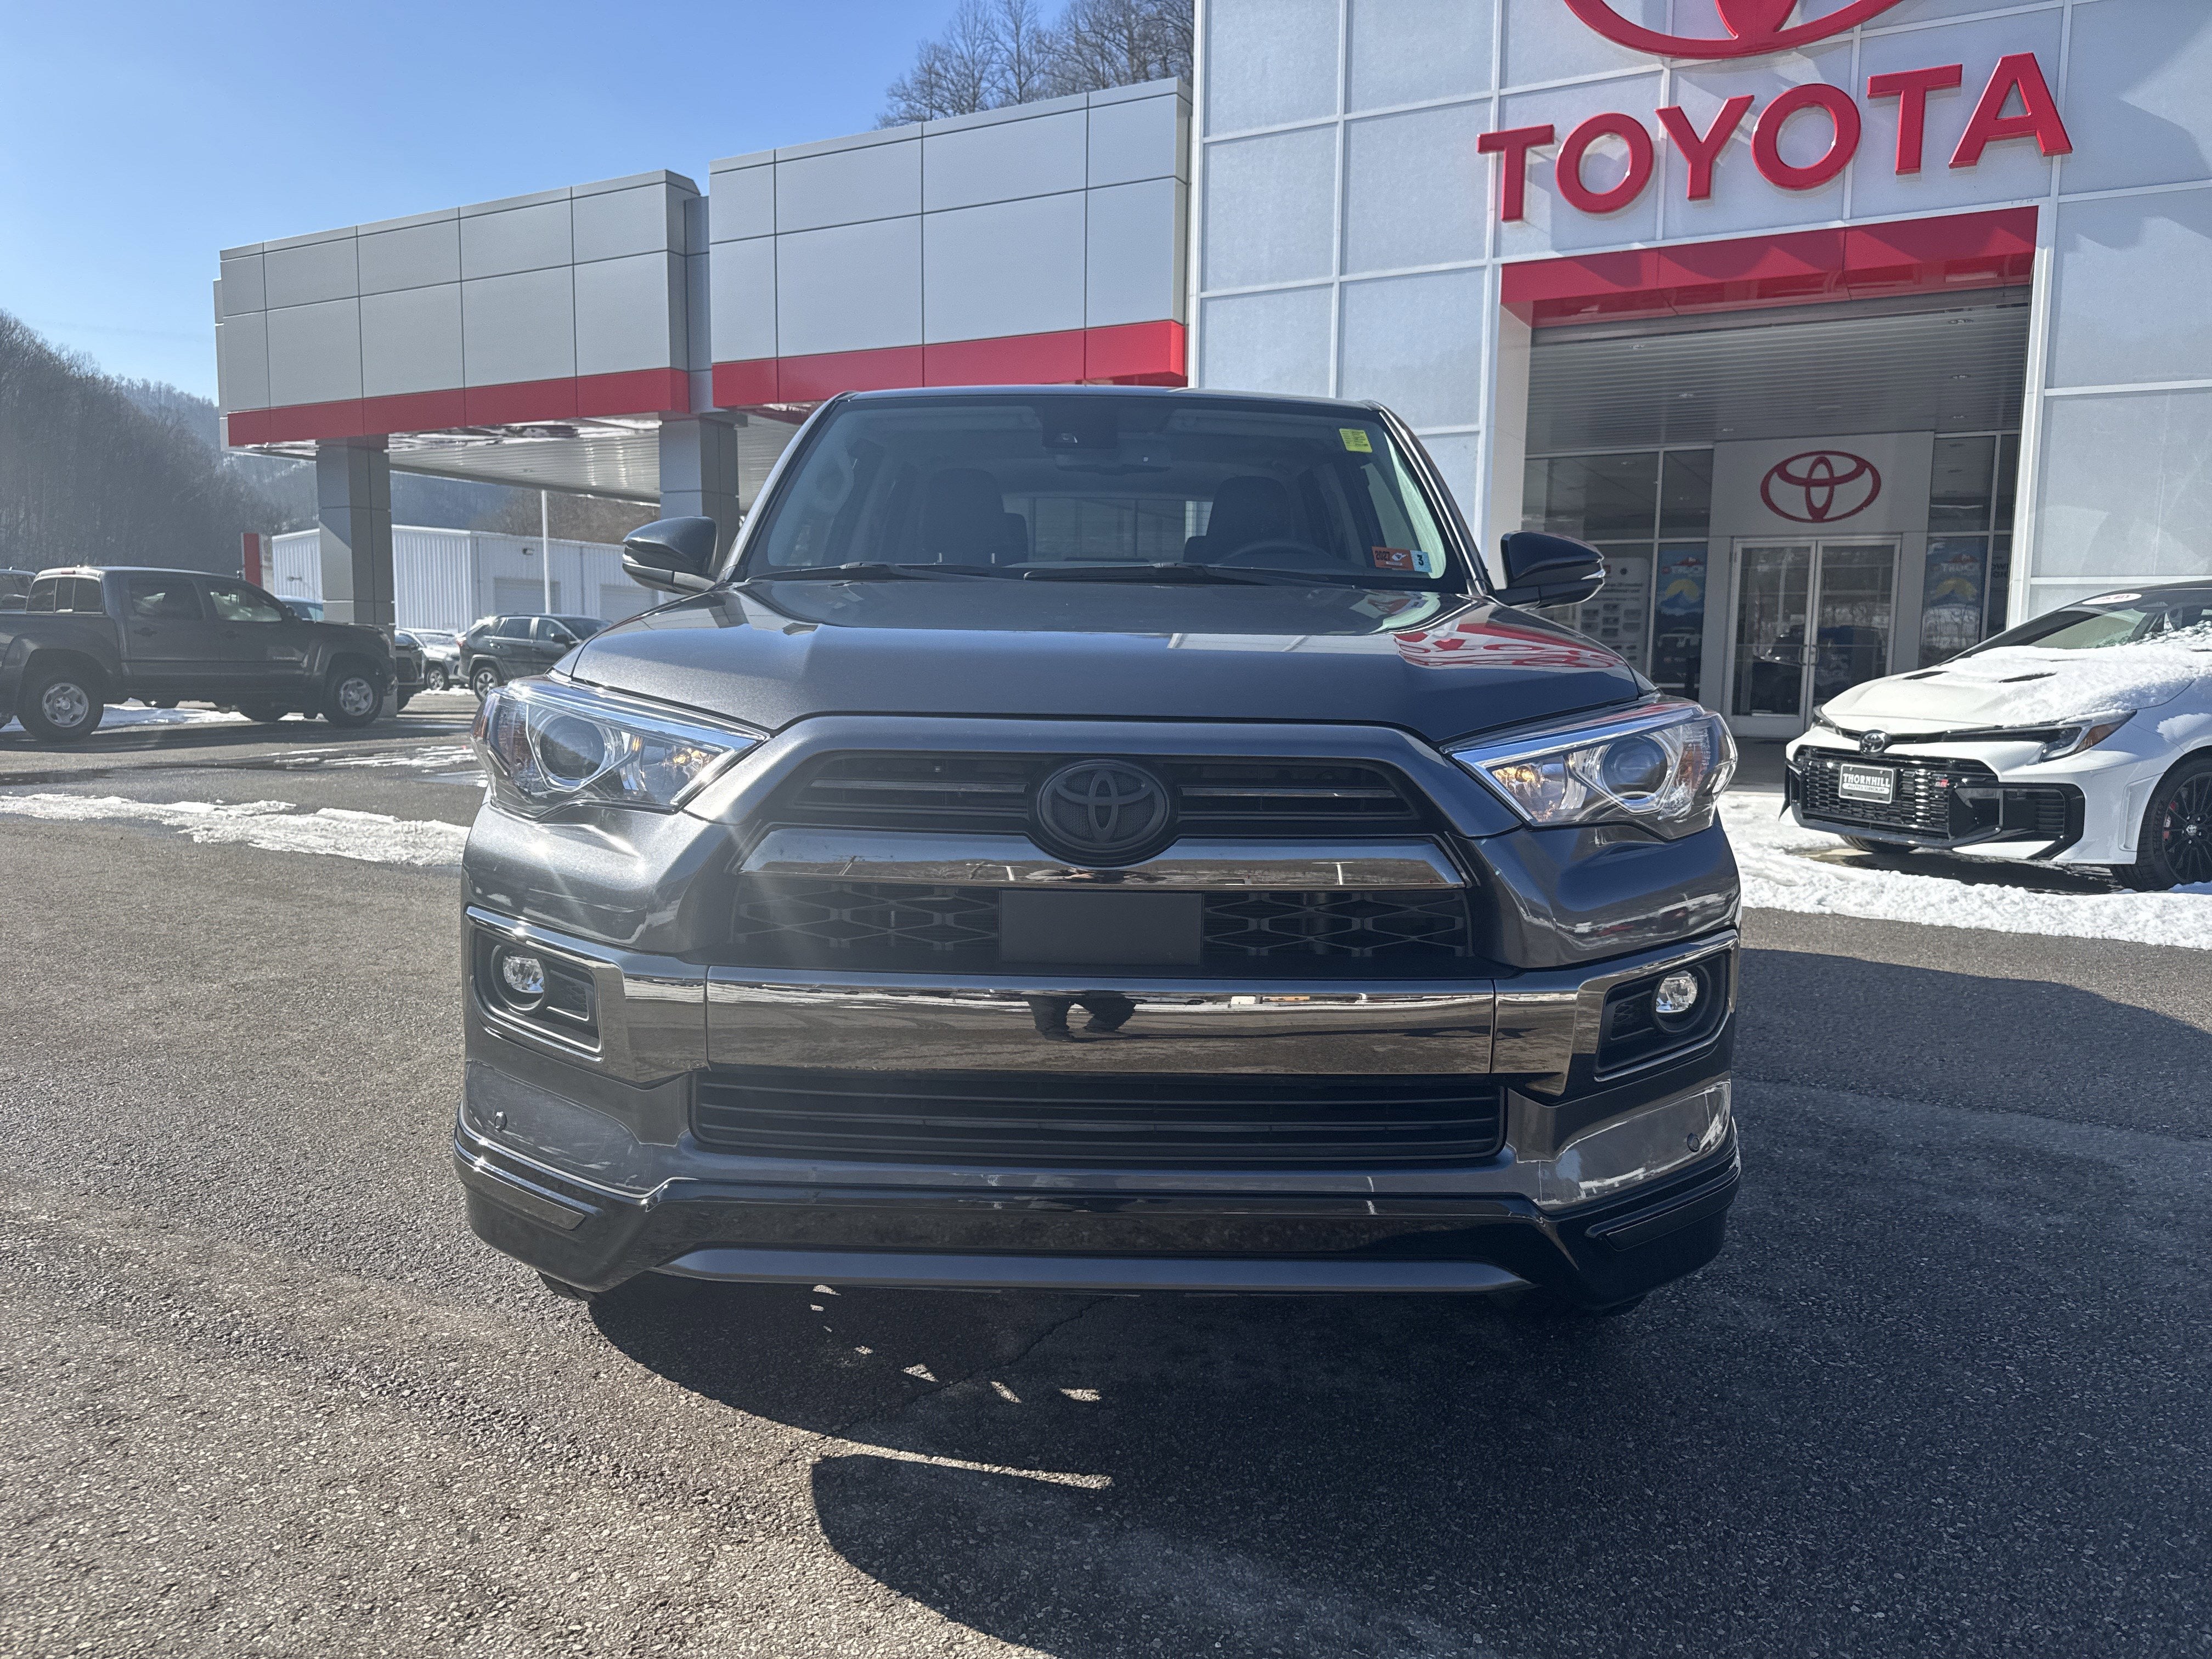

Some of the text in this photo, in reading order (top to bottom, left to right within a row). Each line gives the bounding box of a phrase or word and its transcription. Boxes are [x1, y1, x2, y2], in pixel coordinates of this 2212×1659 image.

[1476, 52, 2073, 223] TOYOTA
[1417, 554, 1424, 566] 3
[1843, 773, 1891, 788] THORNHILL
